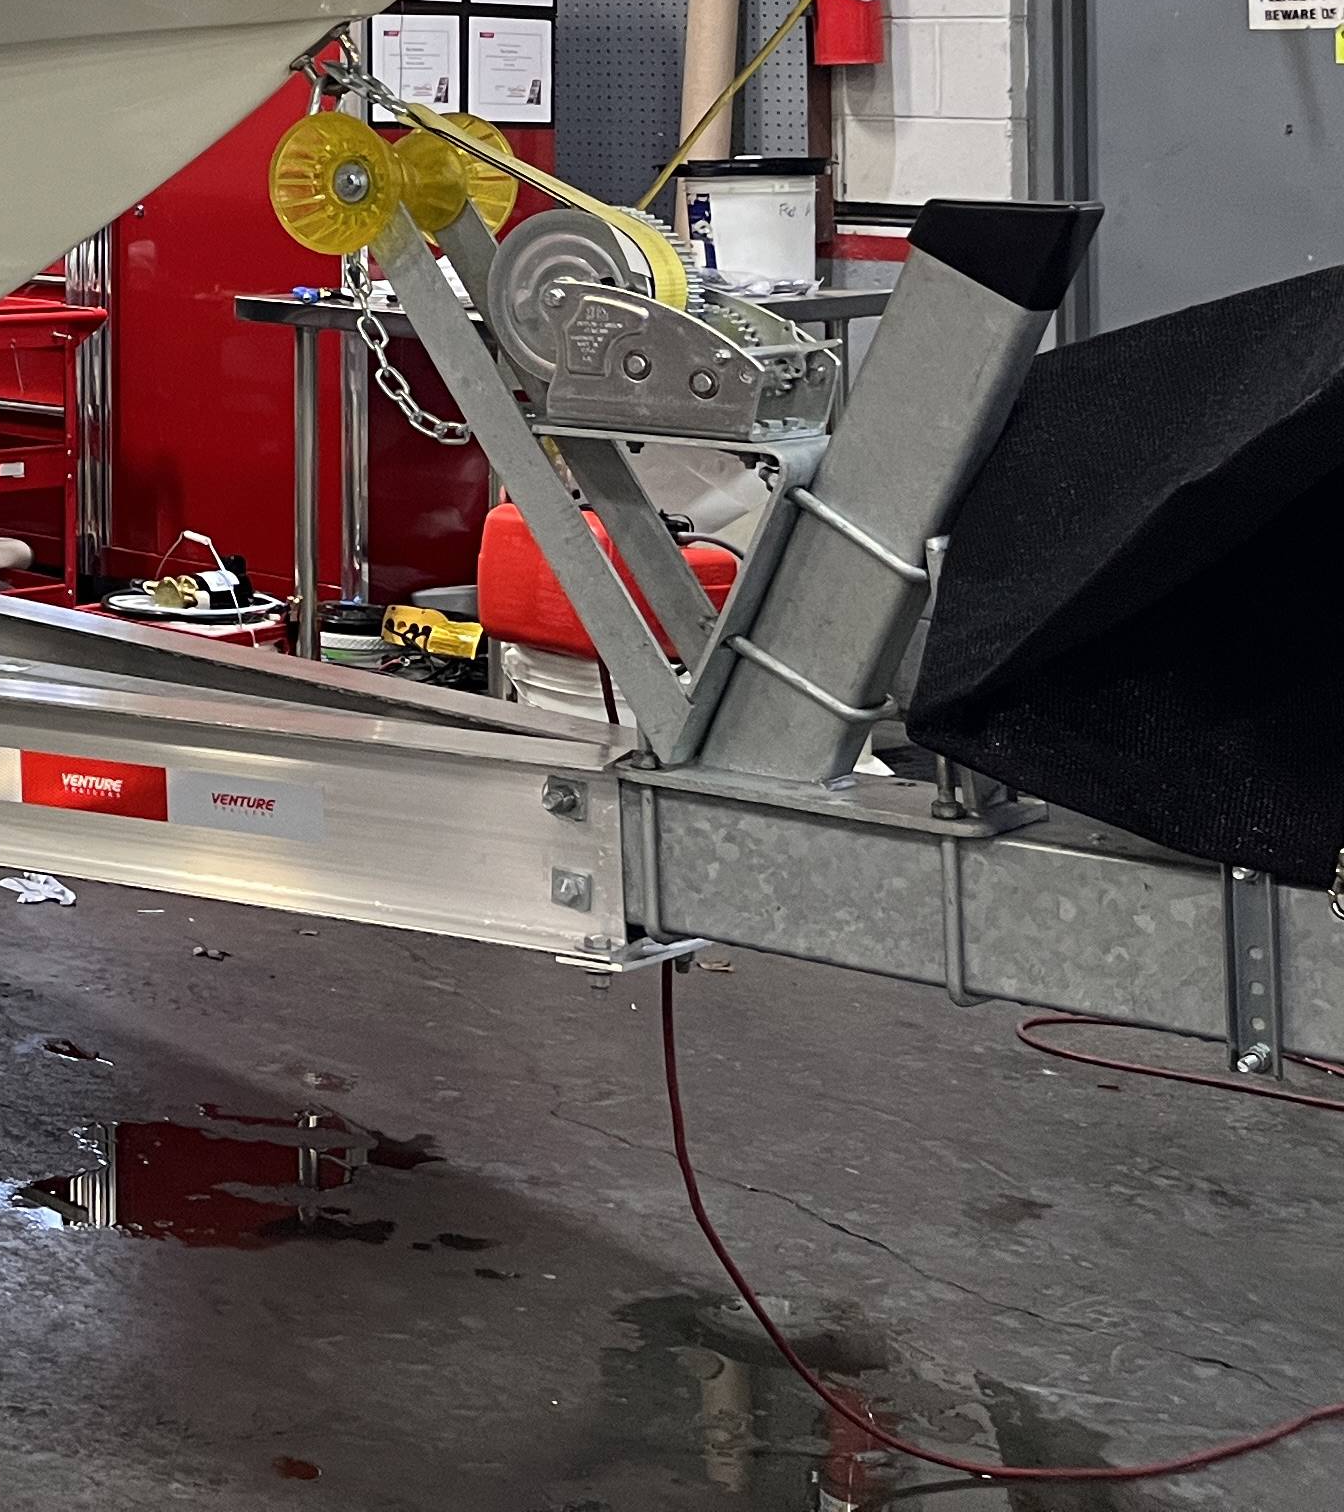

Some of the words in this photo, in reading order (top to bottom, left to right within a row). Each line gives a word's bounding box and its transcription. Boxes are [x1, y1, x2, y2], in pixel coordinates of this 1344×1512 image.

[1264, 9, 1316, 21] BEWARE
[62, 773, 123, 793] VENTURE
[212, 793, 276, 812] VENTURE
